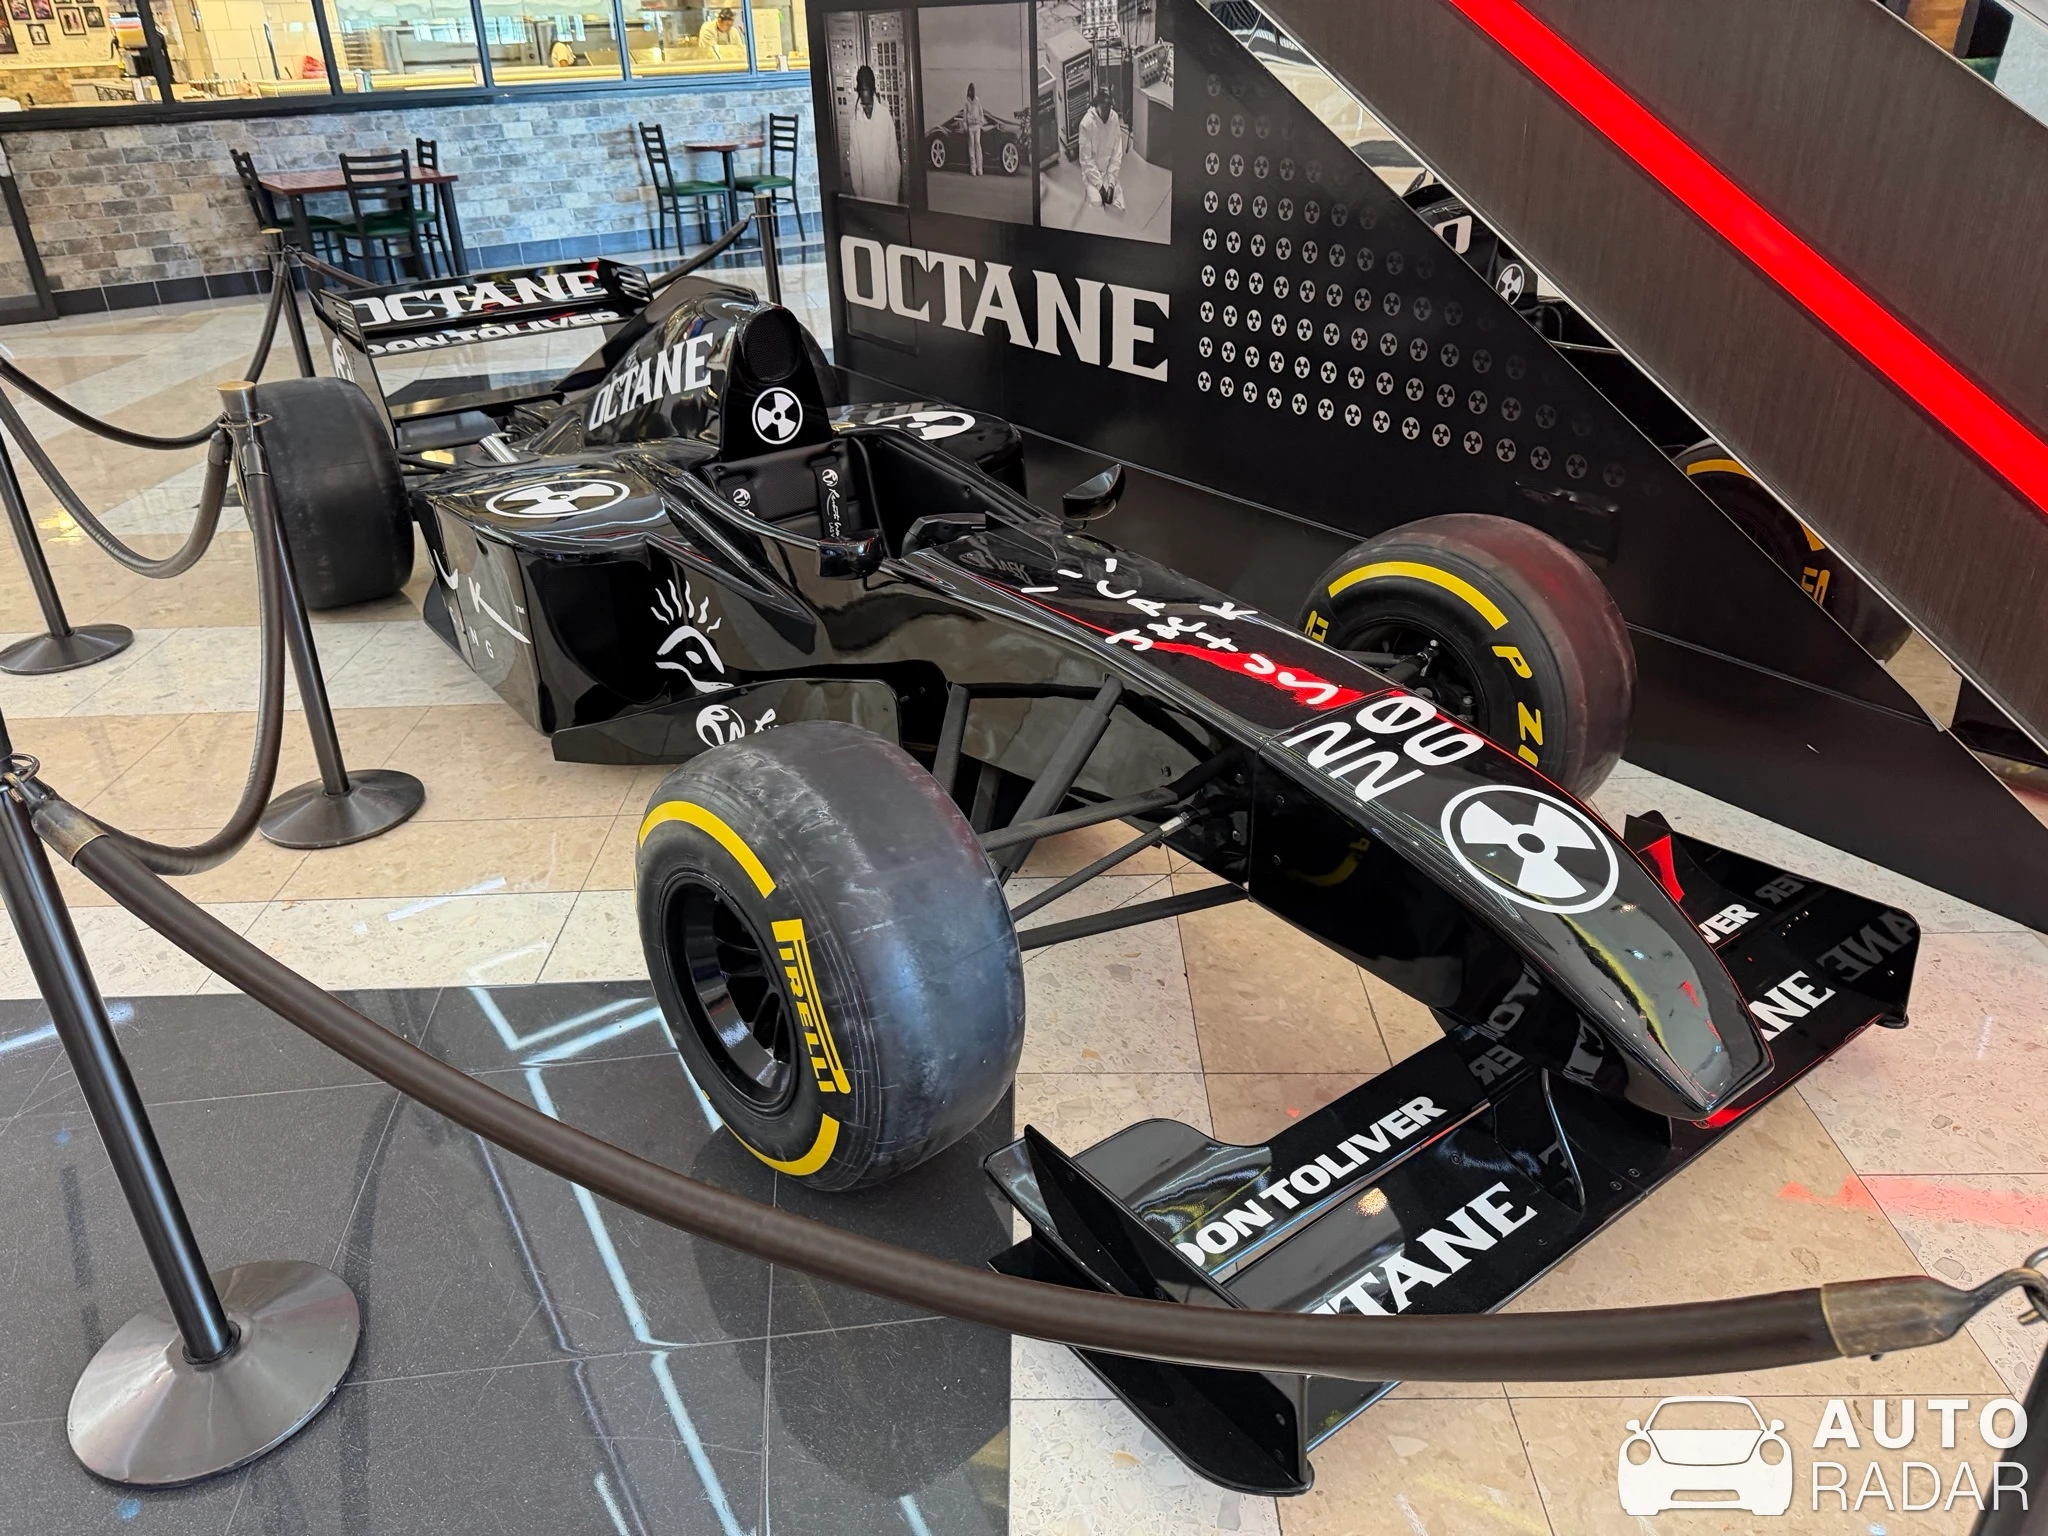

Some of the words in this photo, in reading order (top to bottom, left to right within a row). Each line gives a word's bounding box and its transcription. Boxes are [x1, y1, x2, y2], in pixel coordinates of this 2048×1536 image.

[350, 269, 609, 327] OCTANE
[440, 311, 620, 342] TOLIVER
[840, 235, 1170, 382] OCTANE
[589, 333, 713, 431] OCTANE
[1698, 903, 1760, 944] VER
[771, 918, 852, 1095] PIRELLI
[1258, 1096, 1447, 1210] TOLIVER
[1311, 1182, 1538, 1316] TANE
